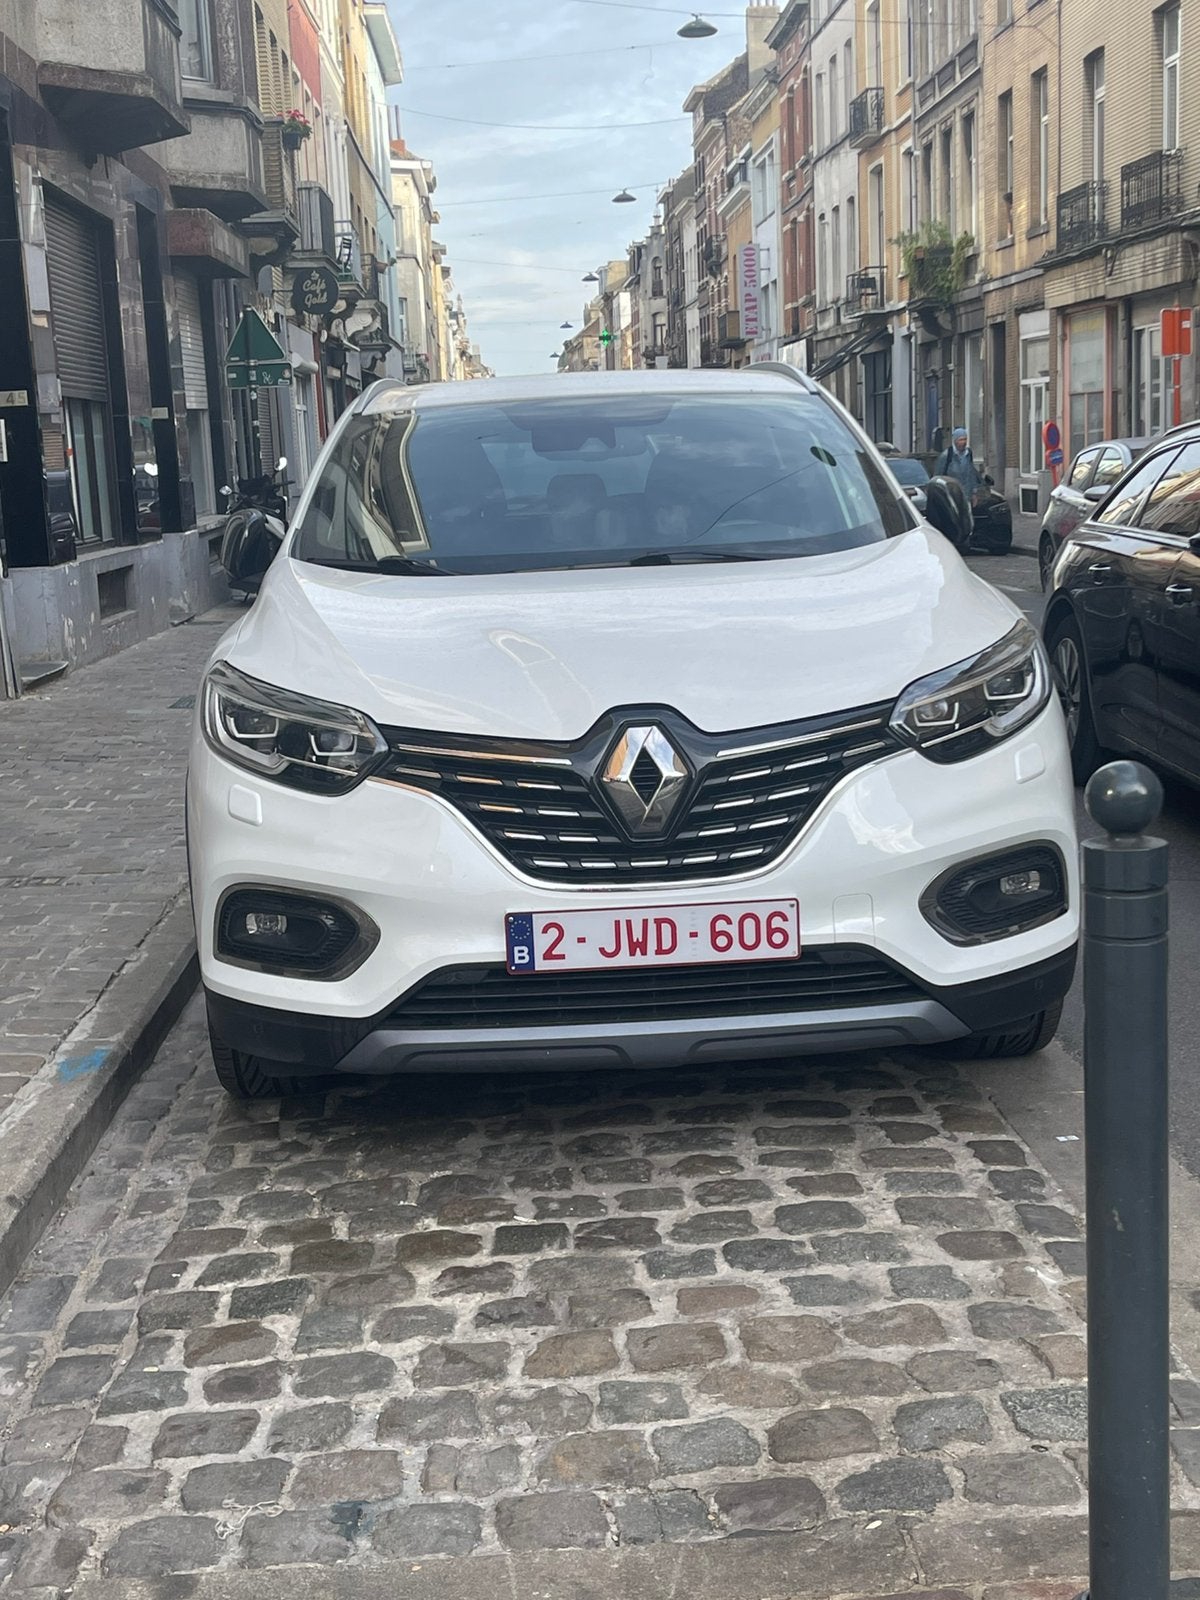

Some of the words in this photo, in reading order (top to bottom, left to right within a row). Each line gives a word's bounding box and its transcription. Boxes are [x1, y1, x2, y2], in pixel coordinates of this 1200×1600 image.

[743, 247, 757, 288] 5000
[302, 279, 326, 293] Café
[744, 293, 758, 336] ETAP
[513, 945, 530, 965] B
